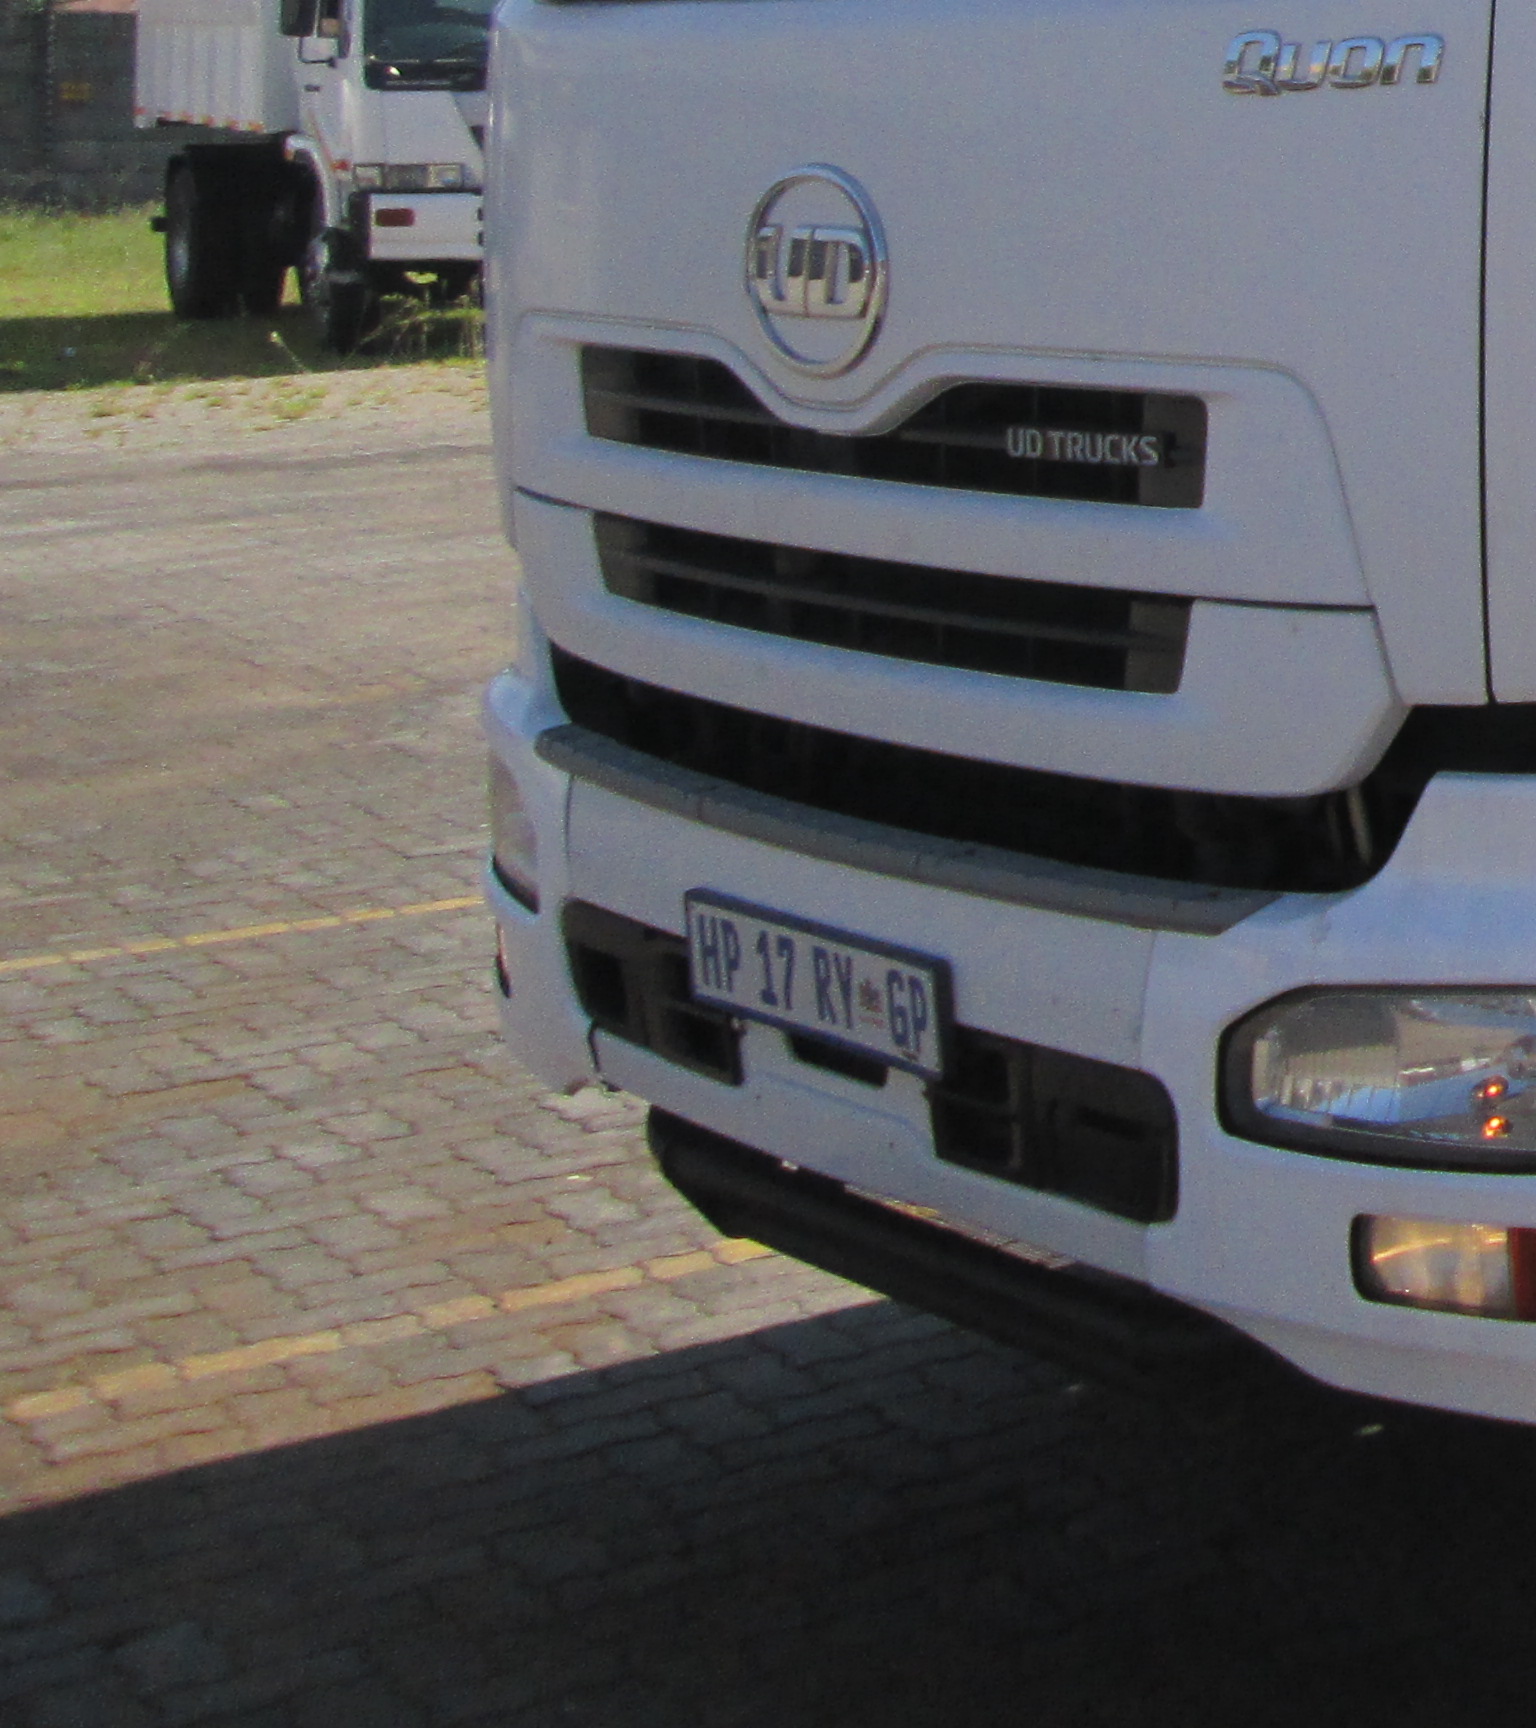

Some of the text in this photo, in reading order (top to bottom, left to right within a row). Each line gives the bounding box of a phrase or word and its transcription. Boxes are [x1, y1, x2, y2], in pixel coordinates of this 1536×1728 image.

[1222, 29, 1446, 95] Quon
[1006, 427, 1160, 466] UD TRUCKS
[699, 913, 928, 1057] HP 17 RY GP
